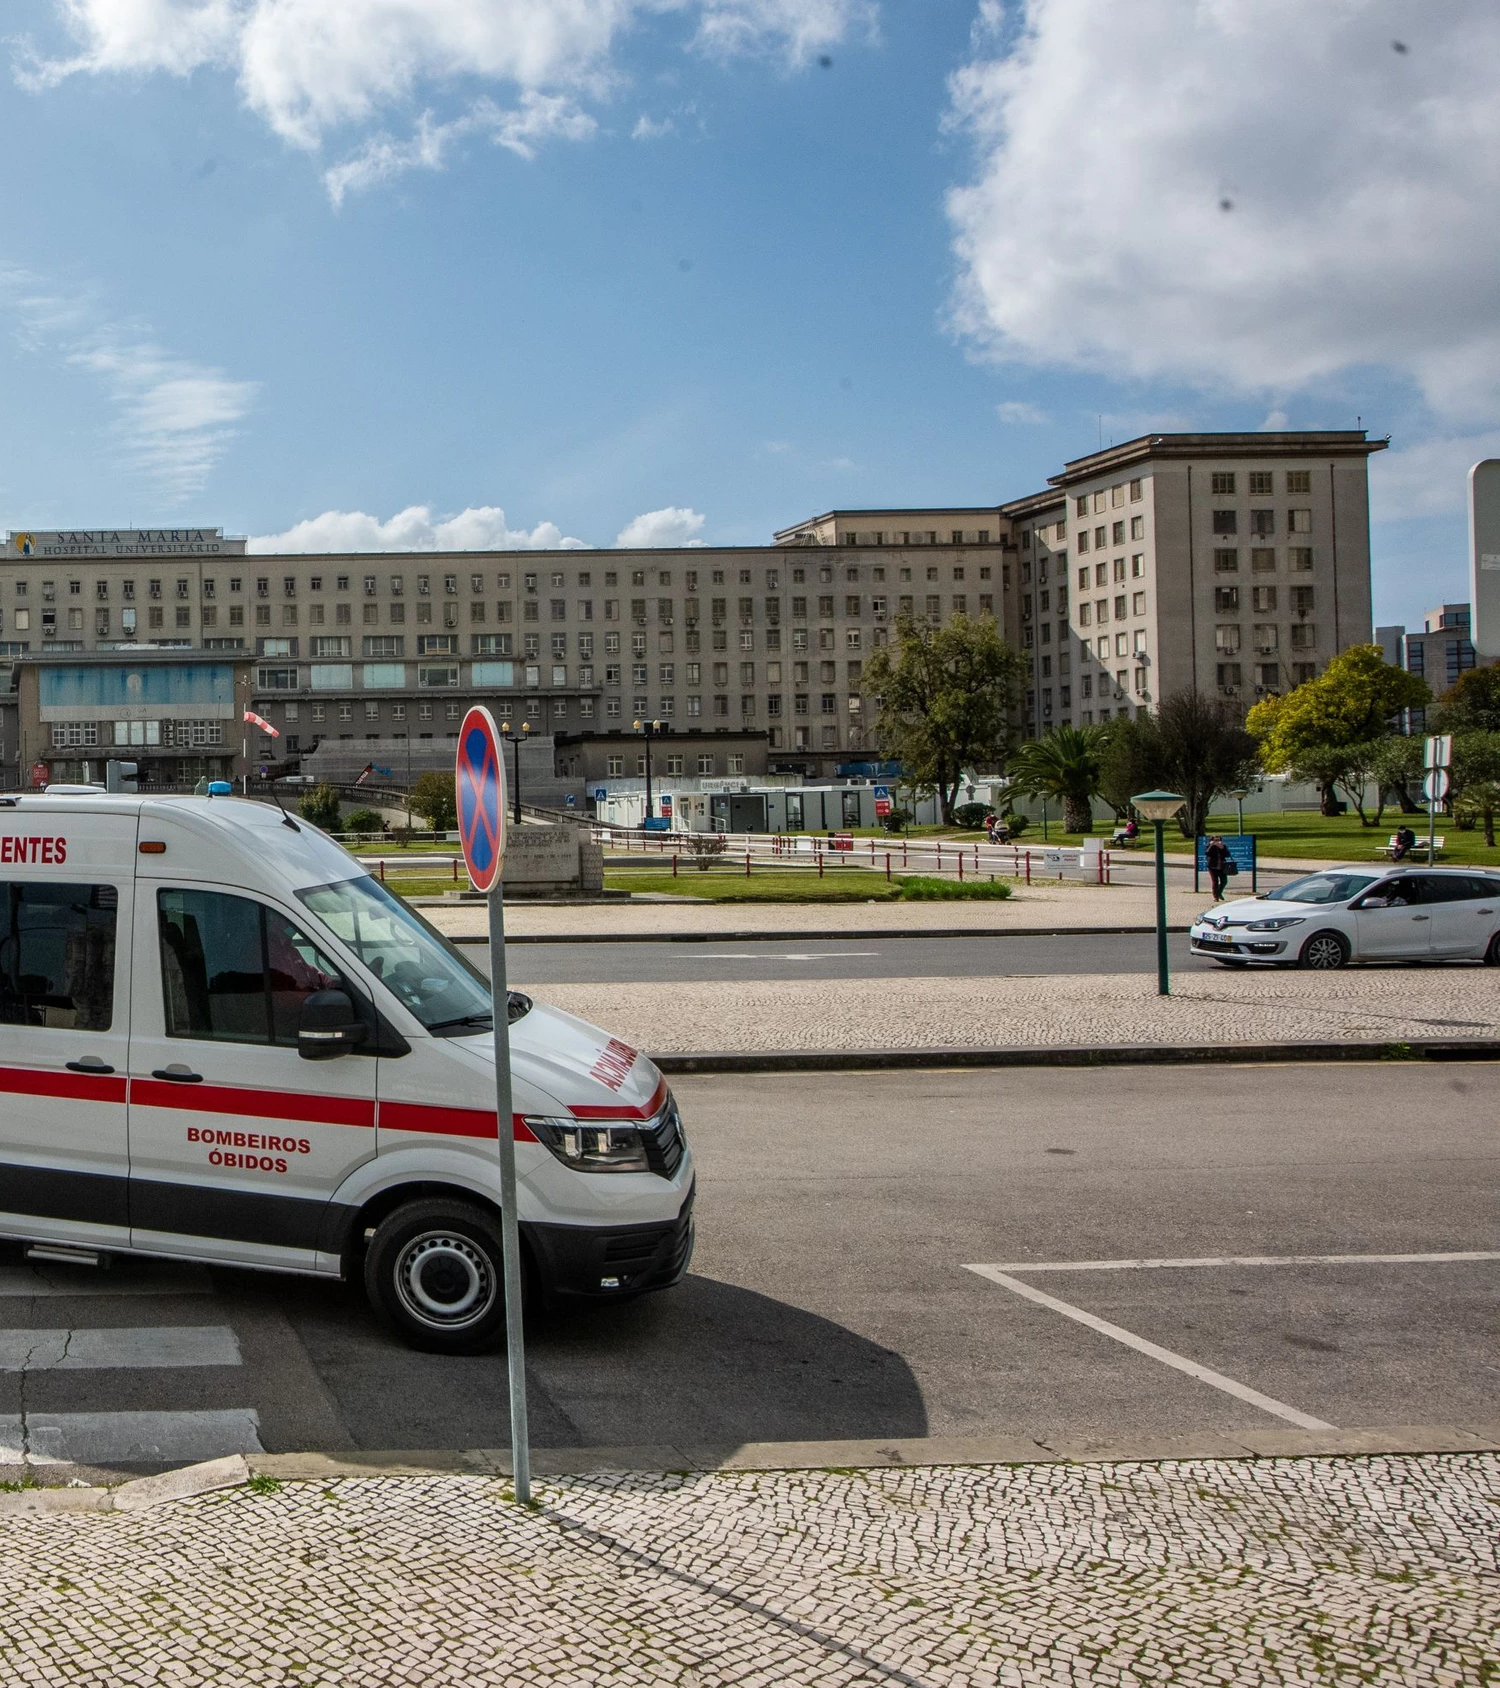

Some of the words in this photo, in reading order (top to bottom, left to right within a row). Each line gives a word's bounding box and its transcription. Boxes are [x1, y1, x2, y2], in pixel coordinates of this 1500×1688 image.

[57, 531, 121, 544] SANTA
[138, 530, 205, 542] MARIA
[44, 546, 107, 555] HOSPITAL
[116, 543, 220, 554] UNIVERSITÁRIO
[187, 1127, 311, 1154] BOMBEIROS
[208, 1148, 288, 1173] ÓBIDOS
